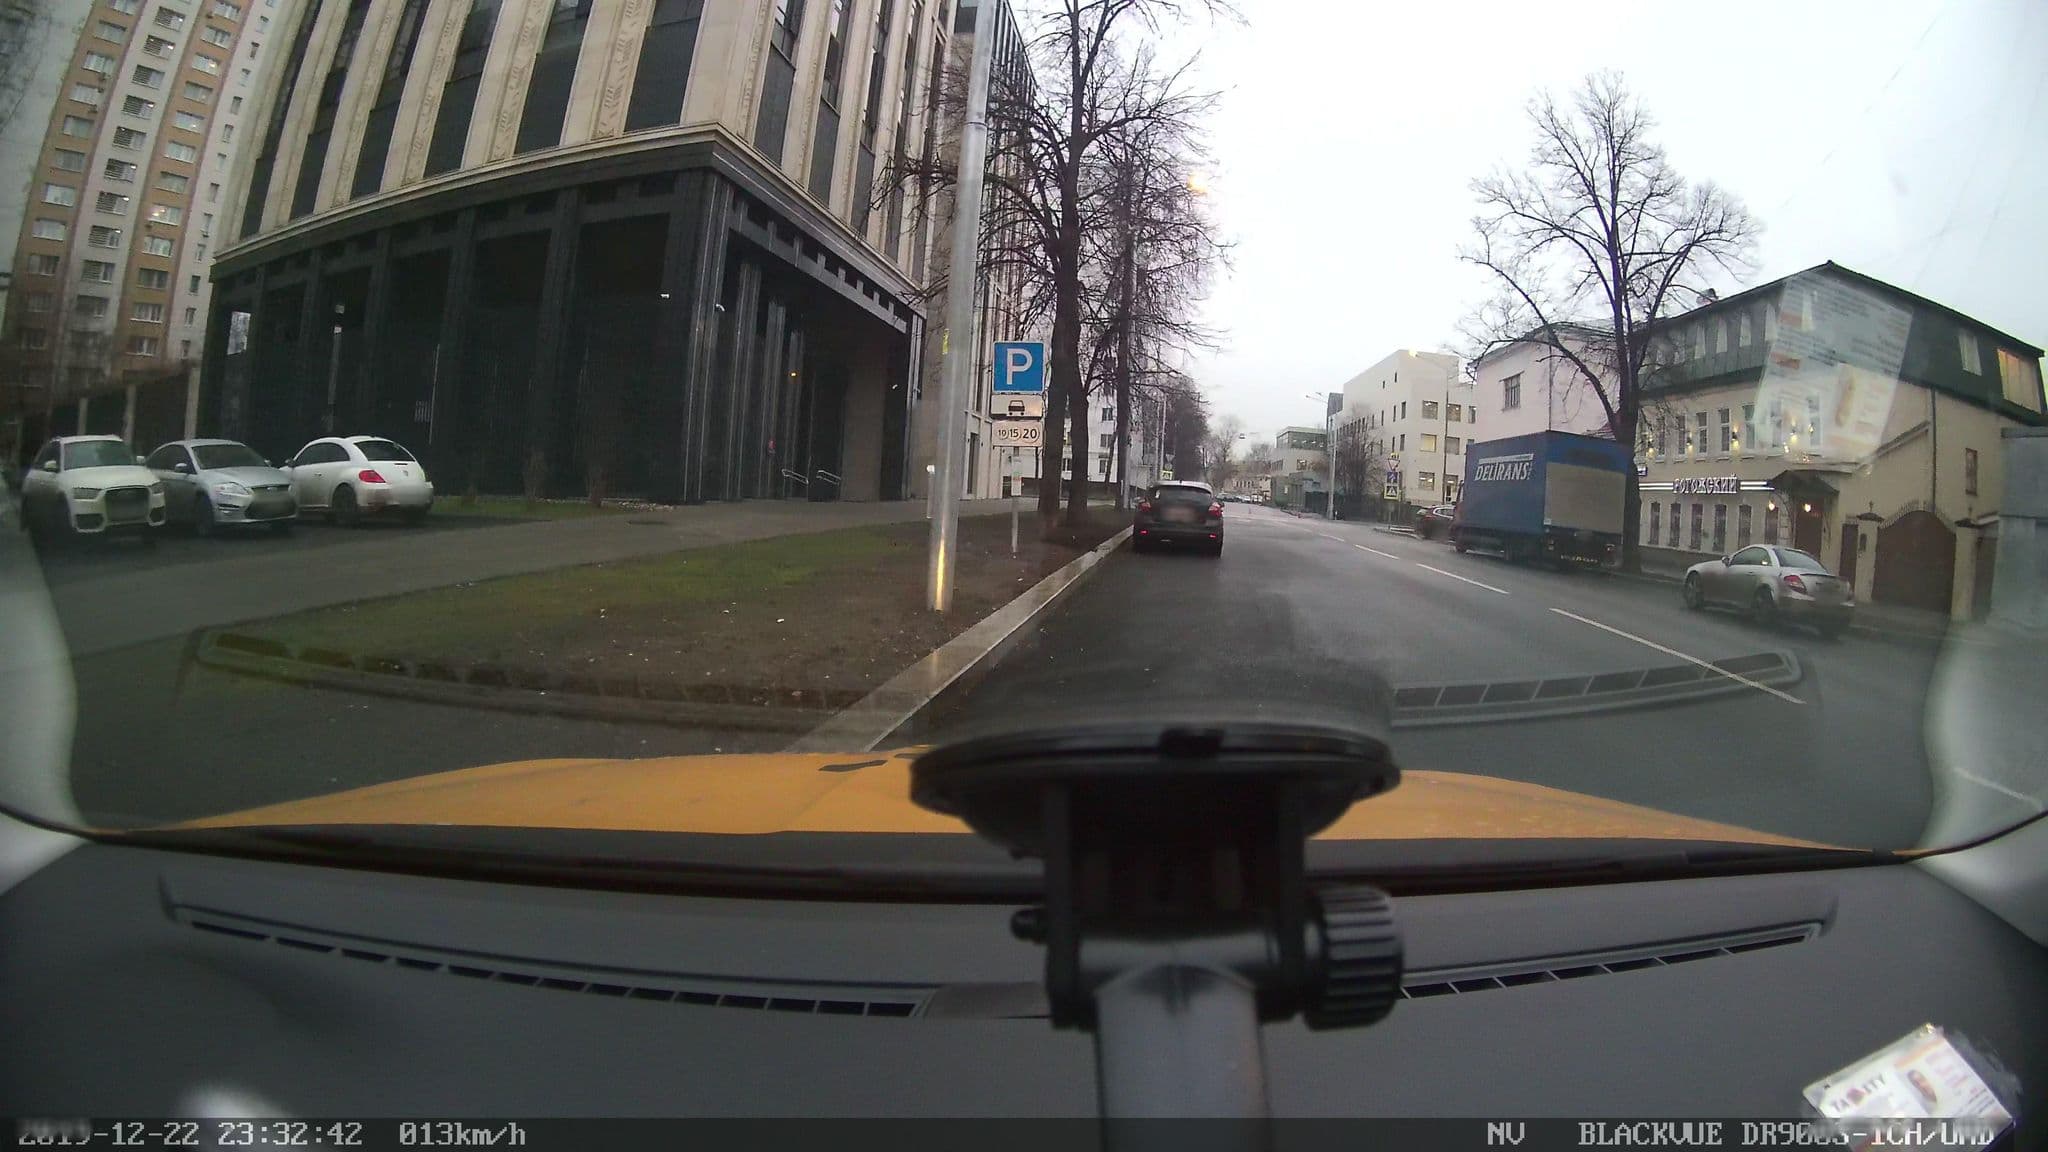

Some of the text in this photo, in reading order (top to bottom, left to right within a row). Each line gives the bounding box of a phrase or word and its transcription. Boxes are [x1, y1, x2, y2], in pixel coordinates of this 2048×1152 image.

[1006, 348, 1033, 385] P
[998, 428, 1038, 439] 10 15 20
